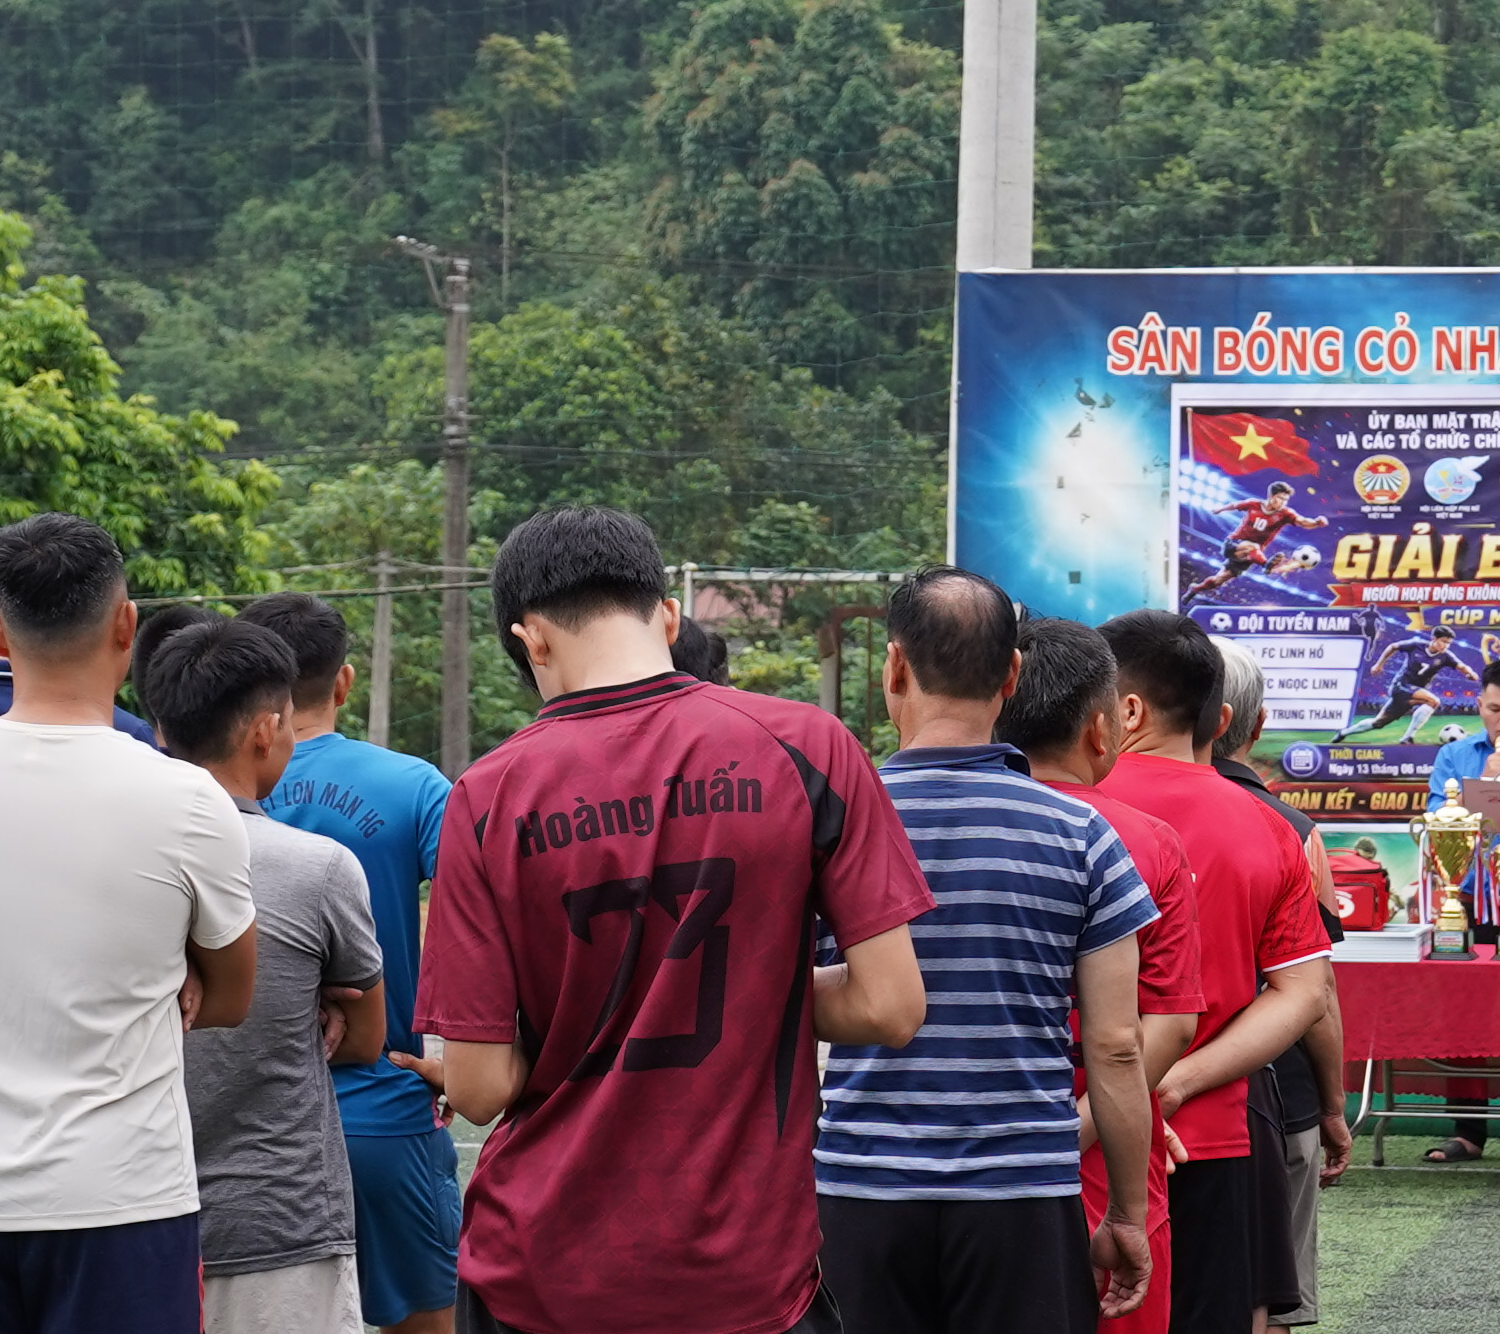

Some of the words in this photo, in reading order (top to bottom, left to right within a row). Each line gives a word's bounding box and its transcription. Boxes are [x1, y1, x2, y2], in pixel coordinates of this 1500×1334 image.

[1107, 311, 1201, 375] SÂN
[1214, 312, 1343, 375] BÓNG
[1355, 311, 1420, 375] CỎ
[1368, 410, 1390, 429] ỦY
[1394, 413, 1428, 429] BAN
[1335, 431, 1358, 449] VÀ
[1362, 431, 1395, 449] CÁC
[1425, 428, 1470, 449] CHỨC
[1333, 522, 1463, 581] GIẢI
[1362, 584, 1399, 602] NGƯỜI
[1401, 586, 1431, 604] HOẠT
[1432, 583, 1464, 603] ĐỘNG
[1238, 613, 1264, 633] ĐỘI
[1317, 616, 1350, 631] NAM
[1440, 606, 1484, 625] CÚP
[1261, 647, 1276, 659] FC
[1280, 647, 1305, 659] LINH
[1278, 678, 1308, 692] NGỌC
[1312, 678, 1338, 690] LINH
[1273, 709, 1304, 720] TRUNG
[1308, 707, 1342, 720] THÀNH
[1355, 749, 1384, 761] GIAN:
[1329, 763, 1355, 777] Ngày
[1357, 763, 1369, 775] 13
[1371, 763, 1399, 777] tháng
[1325, 787, 1355, 810] KẾT
[1370, 792, 1408, 810] GIAO
[318, 782, 364, 820] MÁN
[355, 808, 386, 839] HG
[515, 795, 654, 858] Hoàng
[664, 761, 762, 819] Tuấn
[561, 858, 736, 1082] 23
